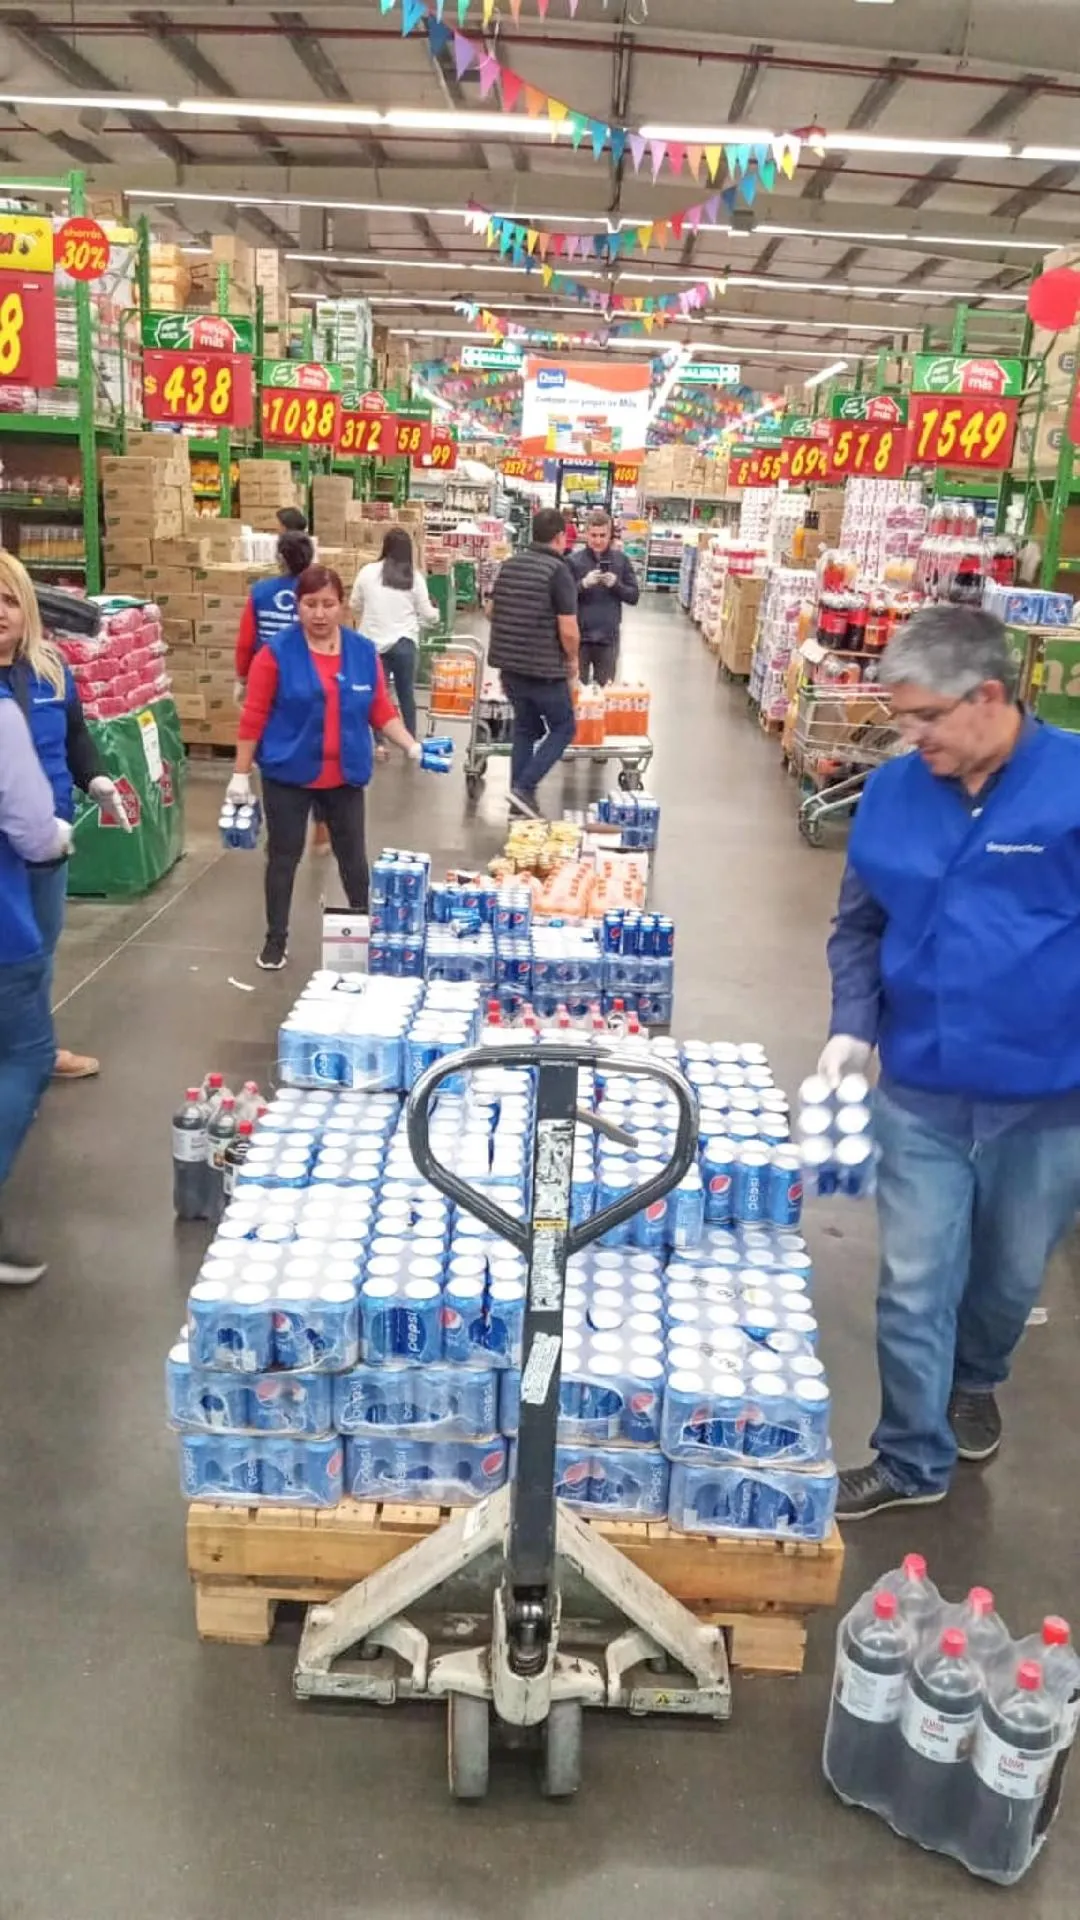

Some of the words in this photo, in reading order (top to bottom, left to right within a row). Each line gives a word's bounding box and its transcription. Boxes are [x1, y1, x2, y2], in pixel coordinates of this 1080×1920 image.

[60, 239, 106, 271] 30%
[144, 374, 157, 394] $
[163, 365, 232, 415] 438
[270, 396, 335, 440] 1038
[340, 419, 383, 450] 312
[397, 426, 422, 451] 58
[917, 407, 1008, 460] 1549
[832, 430, 893, 473] 518
[407, 1311, 421, 1353] pepsi
